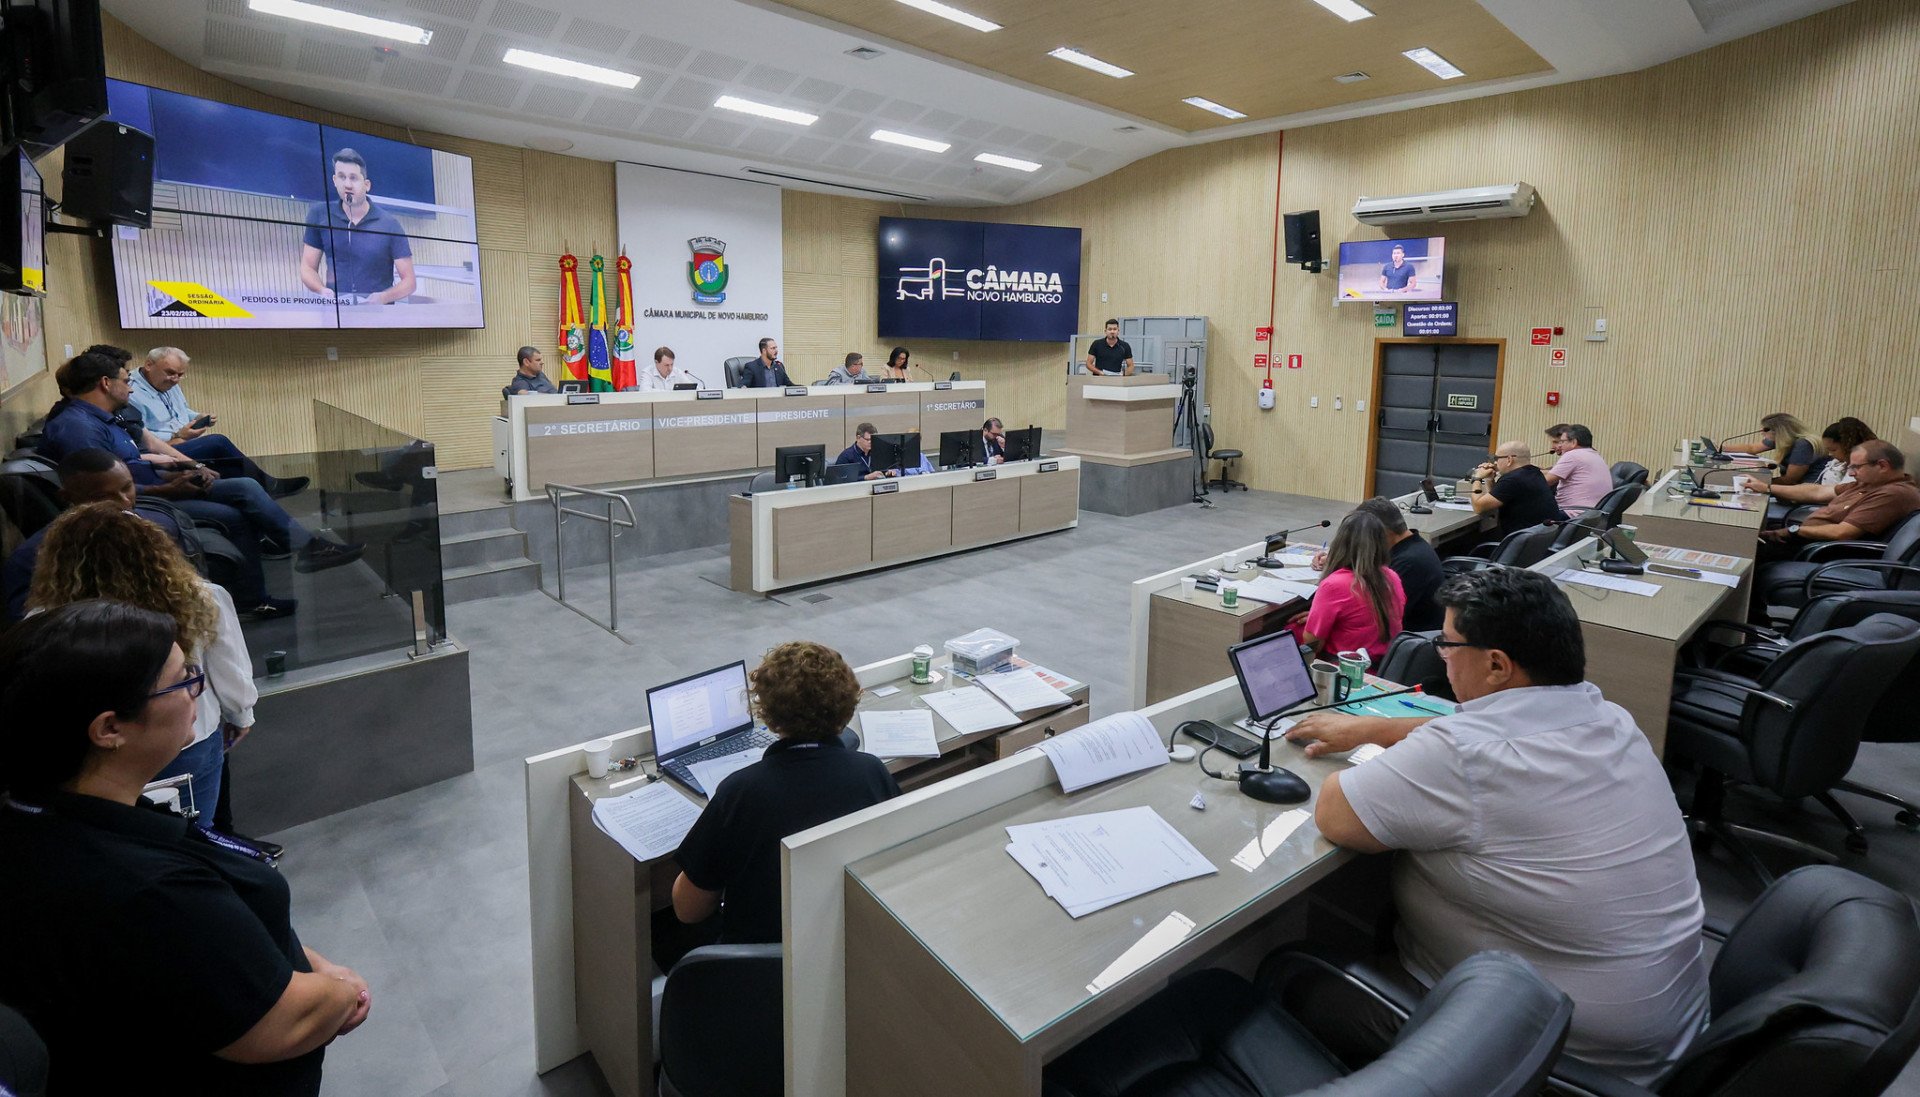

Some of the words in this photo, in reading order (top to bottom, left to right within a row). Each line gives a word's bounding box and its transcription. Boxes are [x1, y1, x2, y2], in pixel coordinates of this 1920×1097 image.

[966, 265, 1063, 292] CÂMARA
[241, 295, 278, 304] PEDIDOS
[280, 296, 291, 304] DE
[293, 295, 350, 306] PROVIDÊNCIAS
[967, 290, 1000, 302] NOVO
[1002, 292, 1062, 304] HAMBURGO
[643, 307, 674, 318] CÂMARA
[674, 310, 707, 319] MUNICIPAL
[708, 311, 716, 320] DE
[717, 312, 735, 320] NOVO
[736, 312, 769, 321] HAMBURGO
[1375, 313, 1395, 324] SAÍDA
[934, 400, 977, 411] SECRETÁRIO
[658, 413, 750, 428] VICE-PRESIDENTE
[775, 408, 829, 420] PRESIDENTE
[560, 419, 640, 435] SECRETÁRIO
